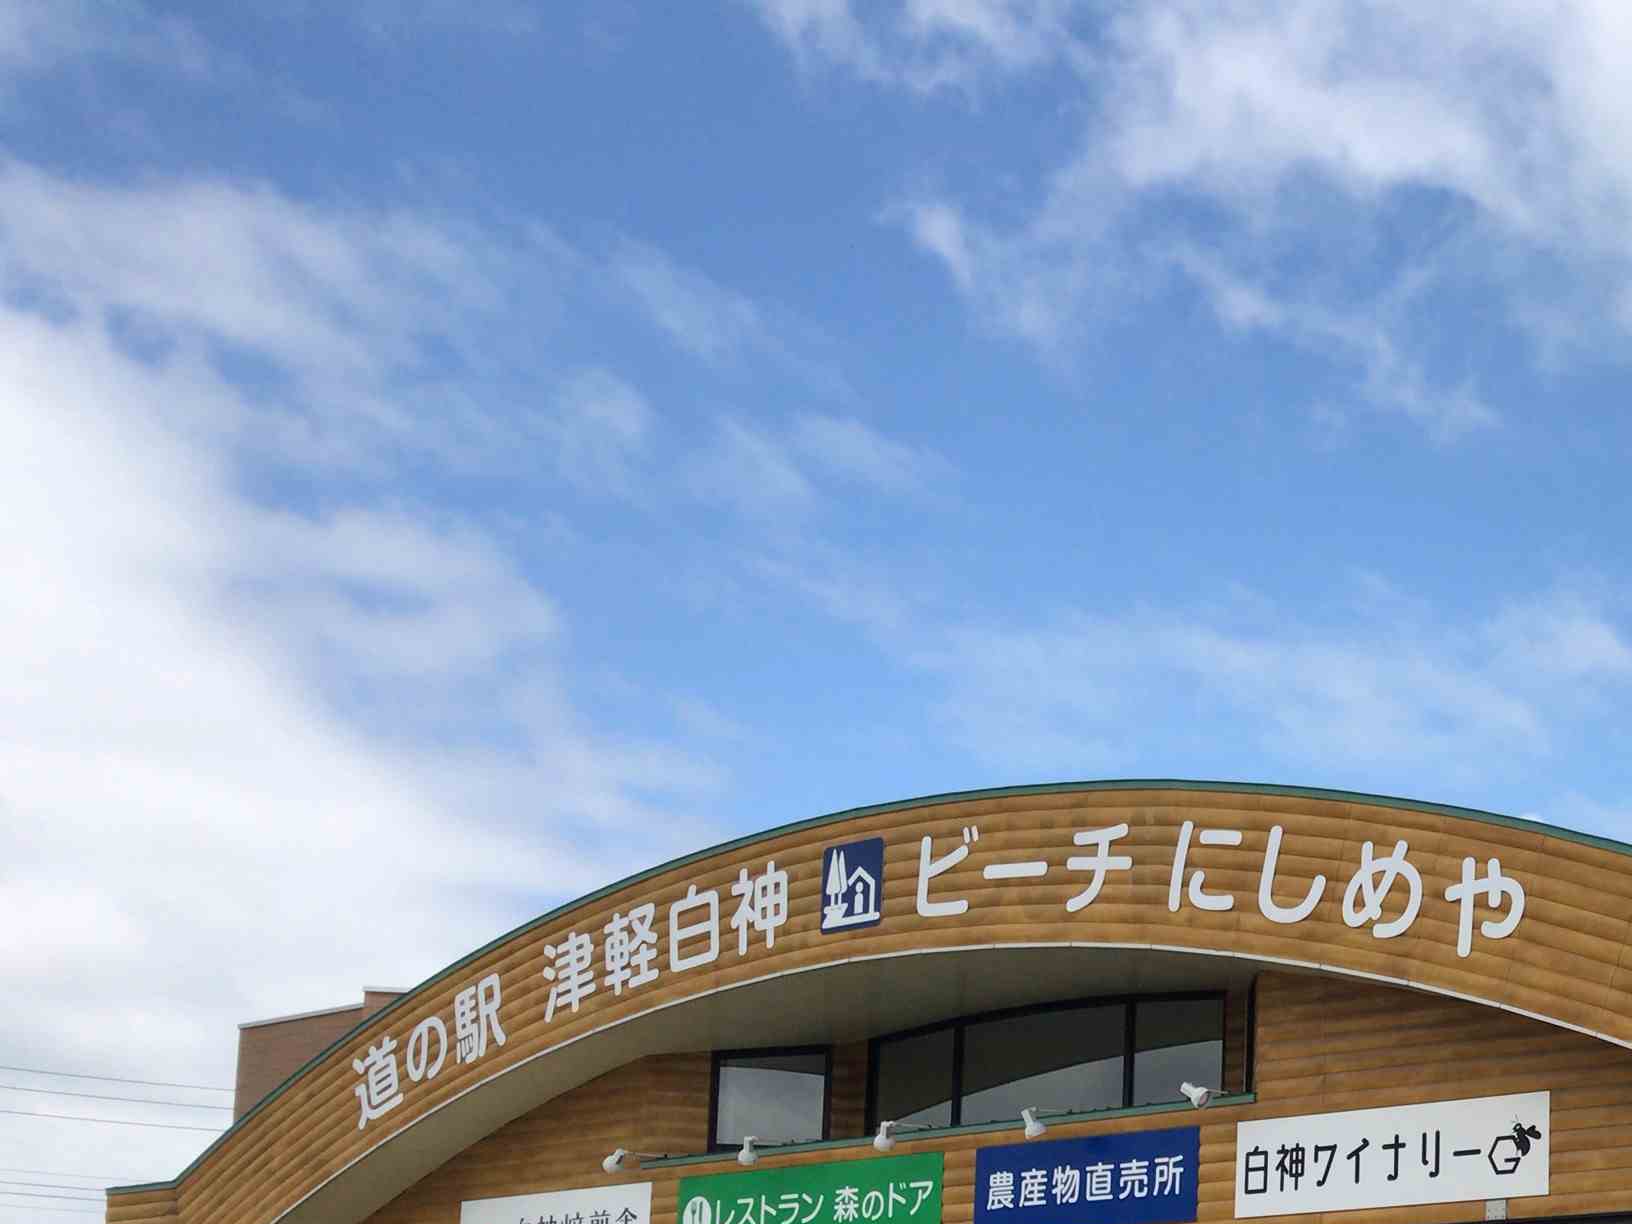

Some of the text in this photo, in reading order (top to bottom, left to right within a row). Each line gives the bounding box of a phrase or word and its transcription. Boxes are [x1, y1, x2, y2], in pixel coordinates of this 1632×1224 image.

[352, 973, 507, 1129] 道の駅
[543, 861, 789, 1022] 津軽白神
[986, 1154, 1185, 1211] 農産物直売所
[1243, 1129, 1481, 1196] 白神ワイナリー
[833, 1179, 934, 1223] 森のドア
